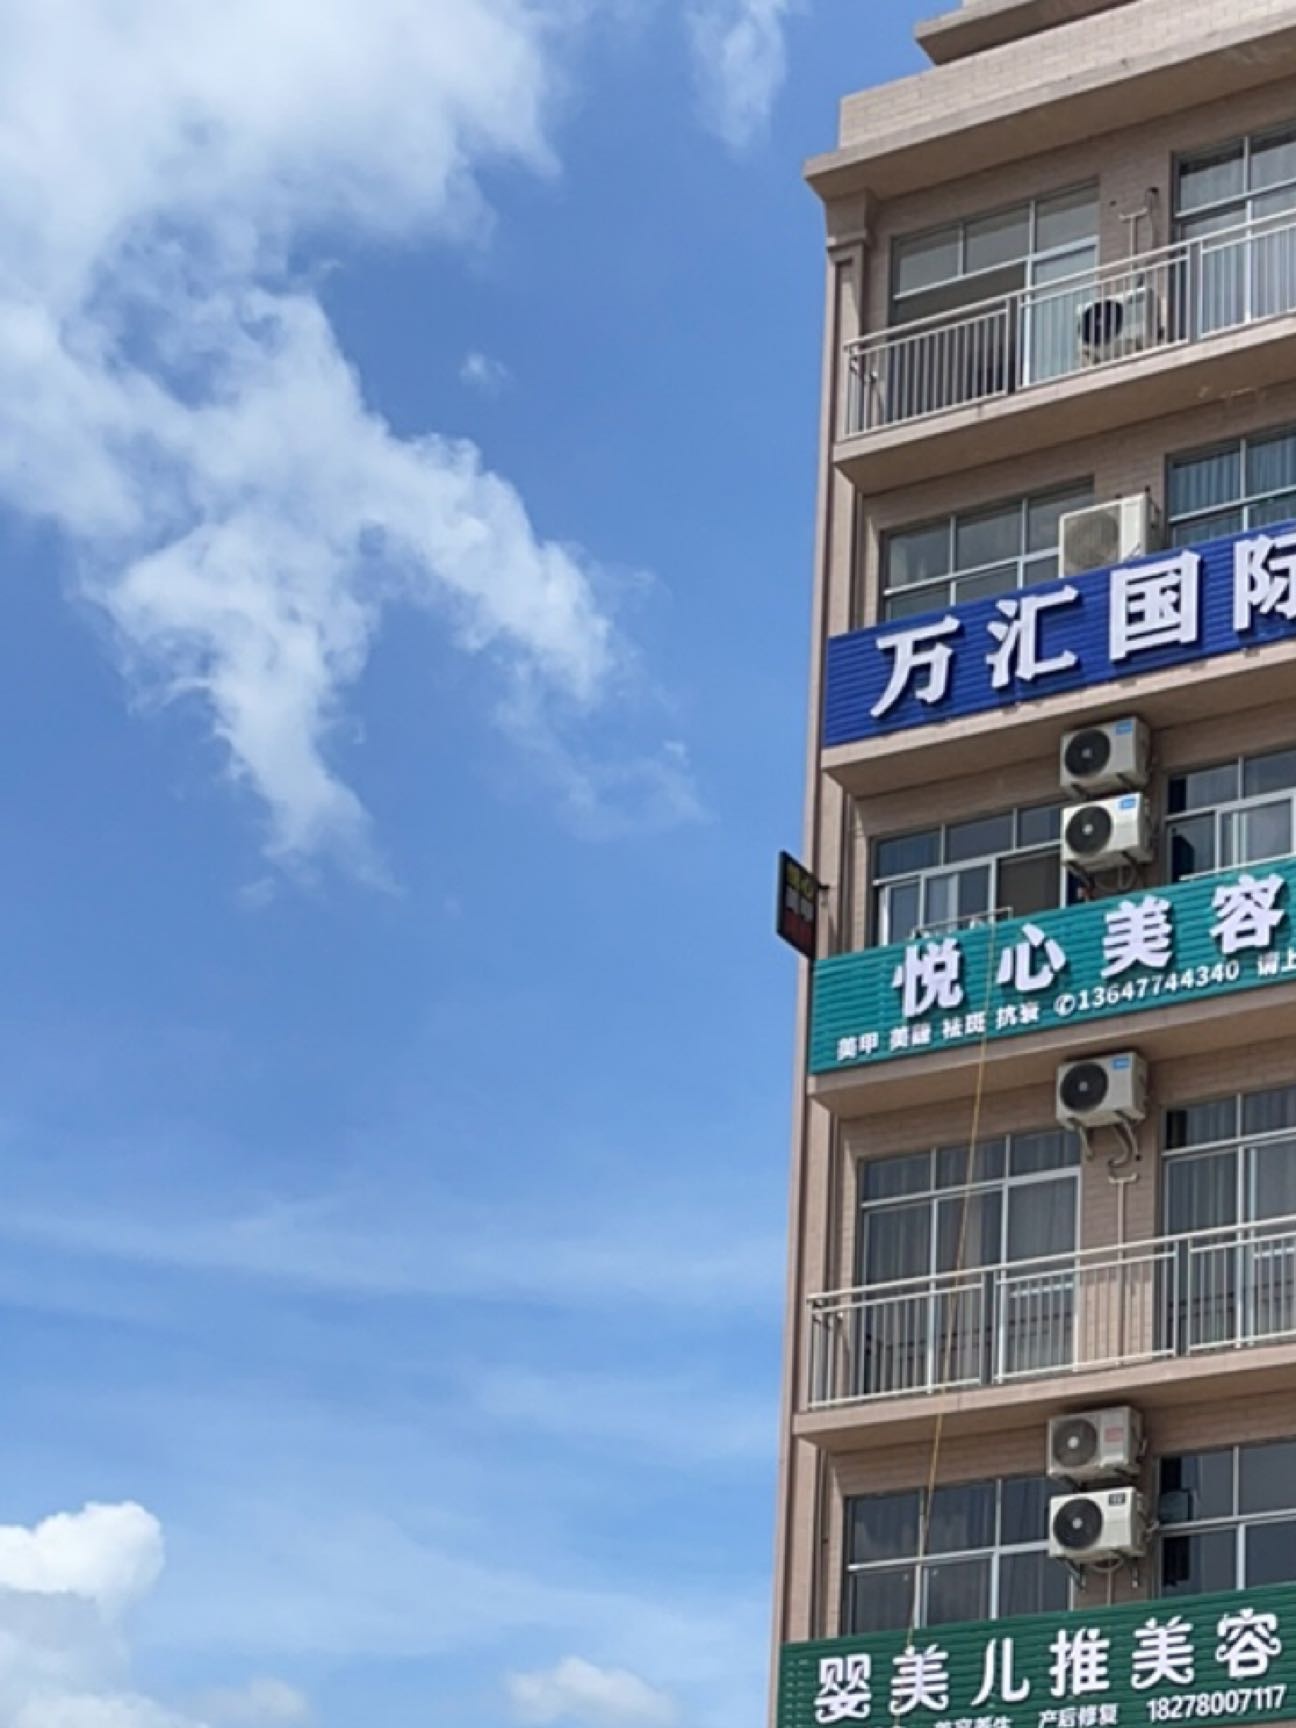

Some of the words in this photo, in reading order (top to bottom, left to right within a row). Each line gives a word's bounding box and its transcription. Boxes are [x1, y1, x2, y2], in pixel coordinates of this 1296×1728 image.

[893, 874, 1284, 1017] 悦心美容
[814, 1608, 1282, 1725] 婴美儿推美容
[1146, 1685, 1287, 1723] 18278007117
